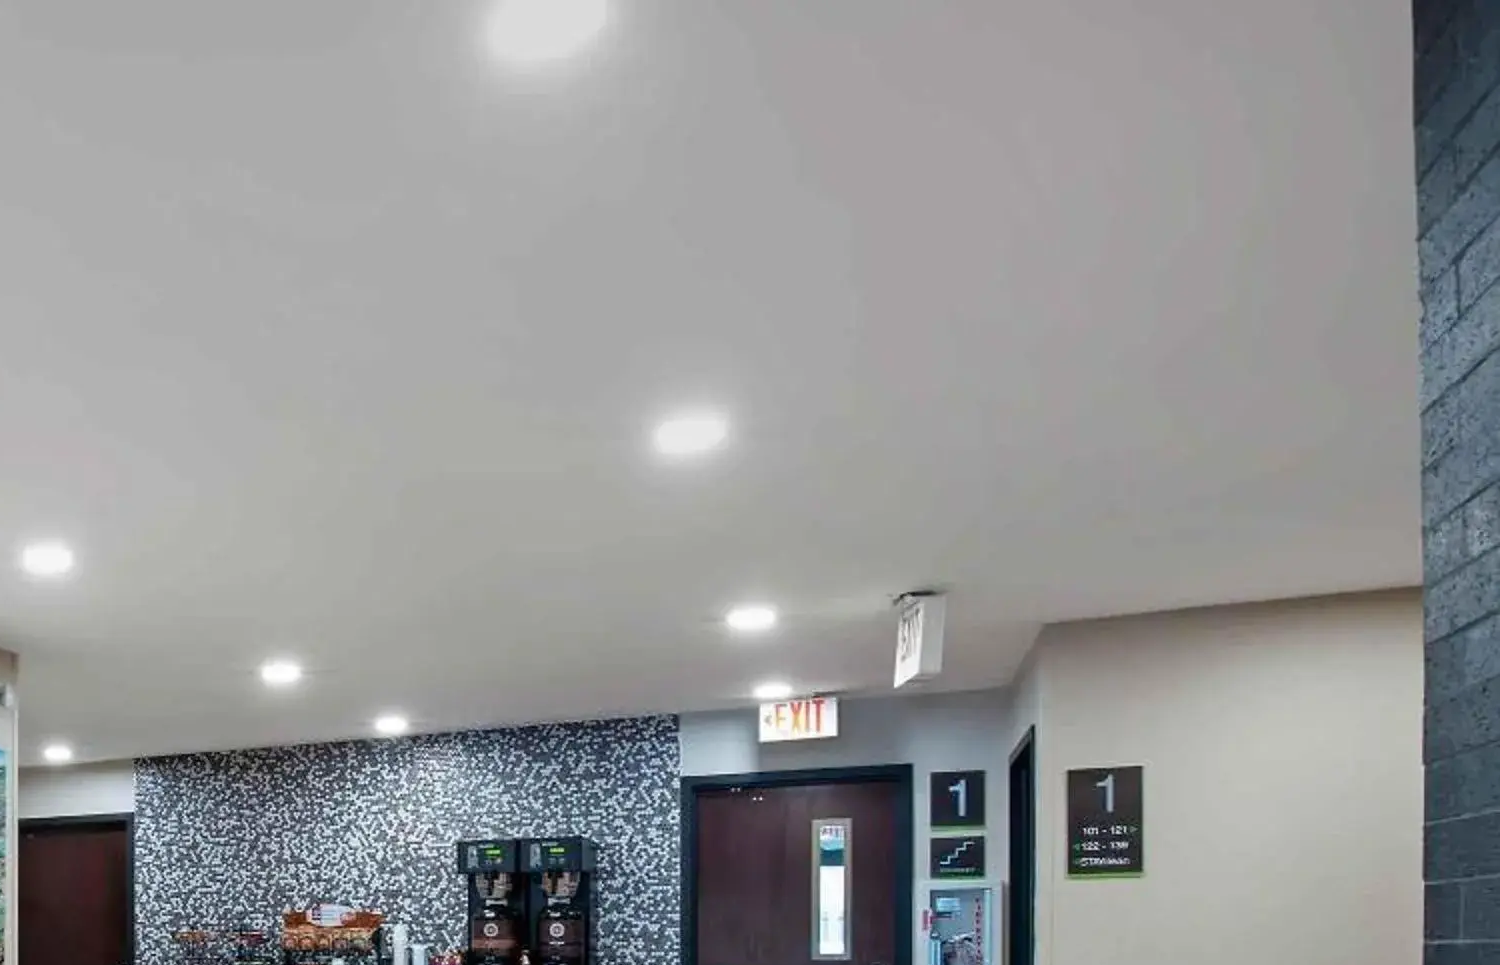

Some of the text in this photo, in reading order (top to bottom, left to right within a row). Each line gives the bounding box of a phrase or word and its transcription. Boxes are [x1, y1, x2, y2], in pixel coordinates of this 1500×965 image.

[774, 699, 825, 734] EXIT
[948, 779, 966, 817] 1
[1095, 773, 1114, 812] 1
[1083, 827, 1099, 835] 101
[1110, 825, 1127, 835] 121
